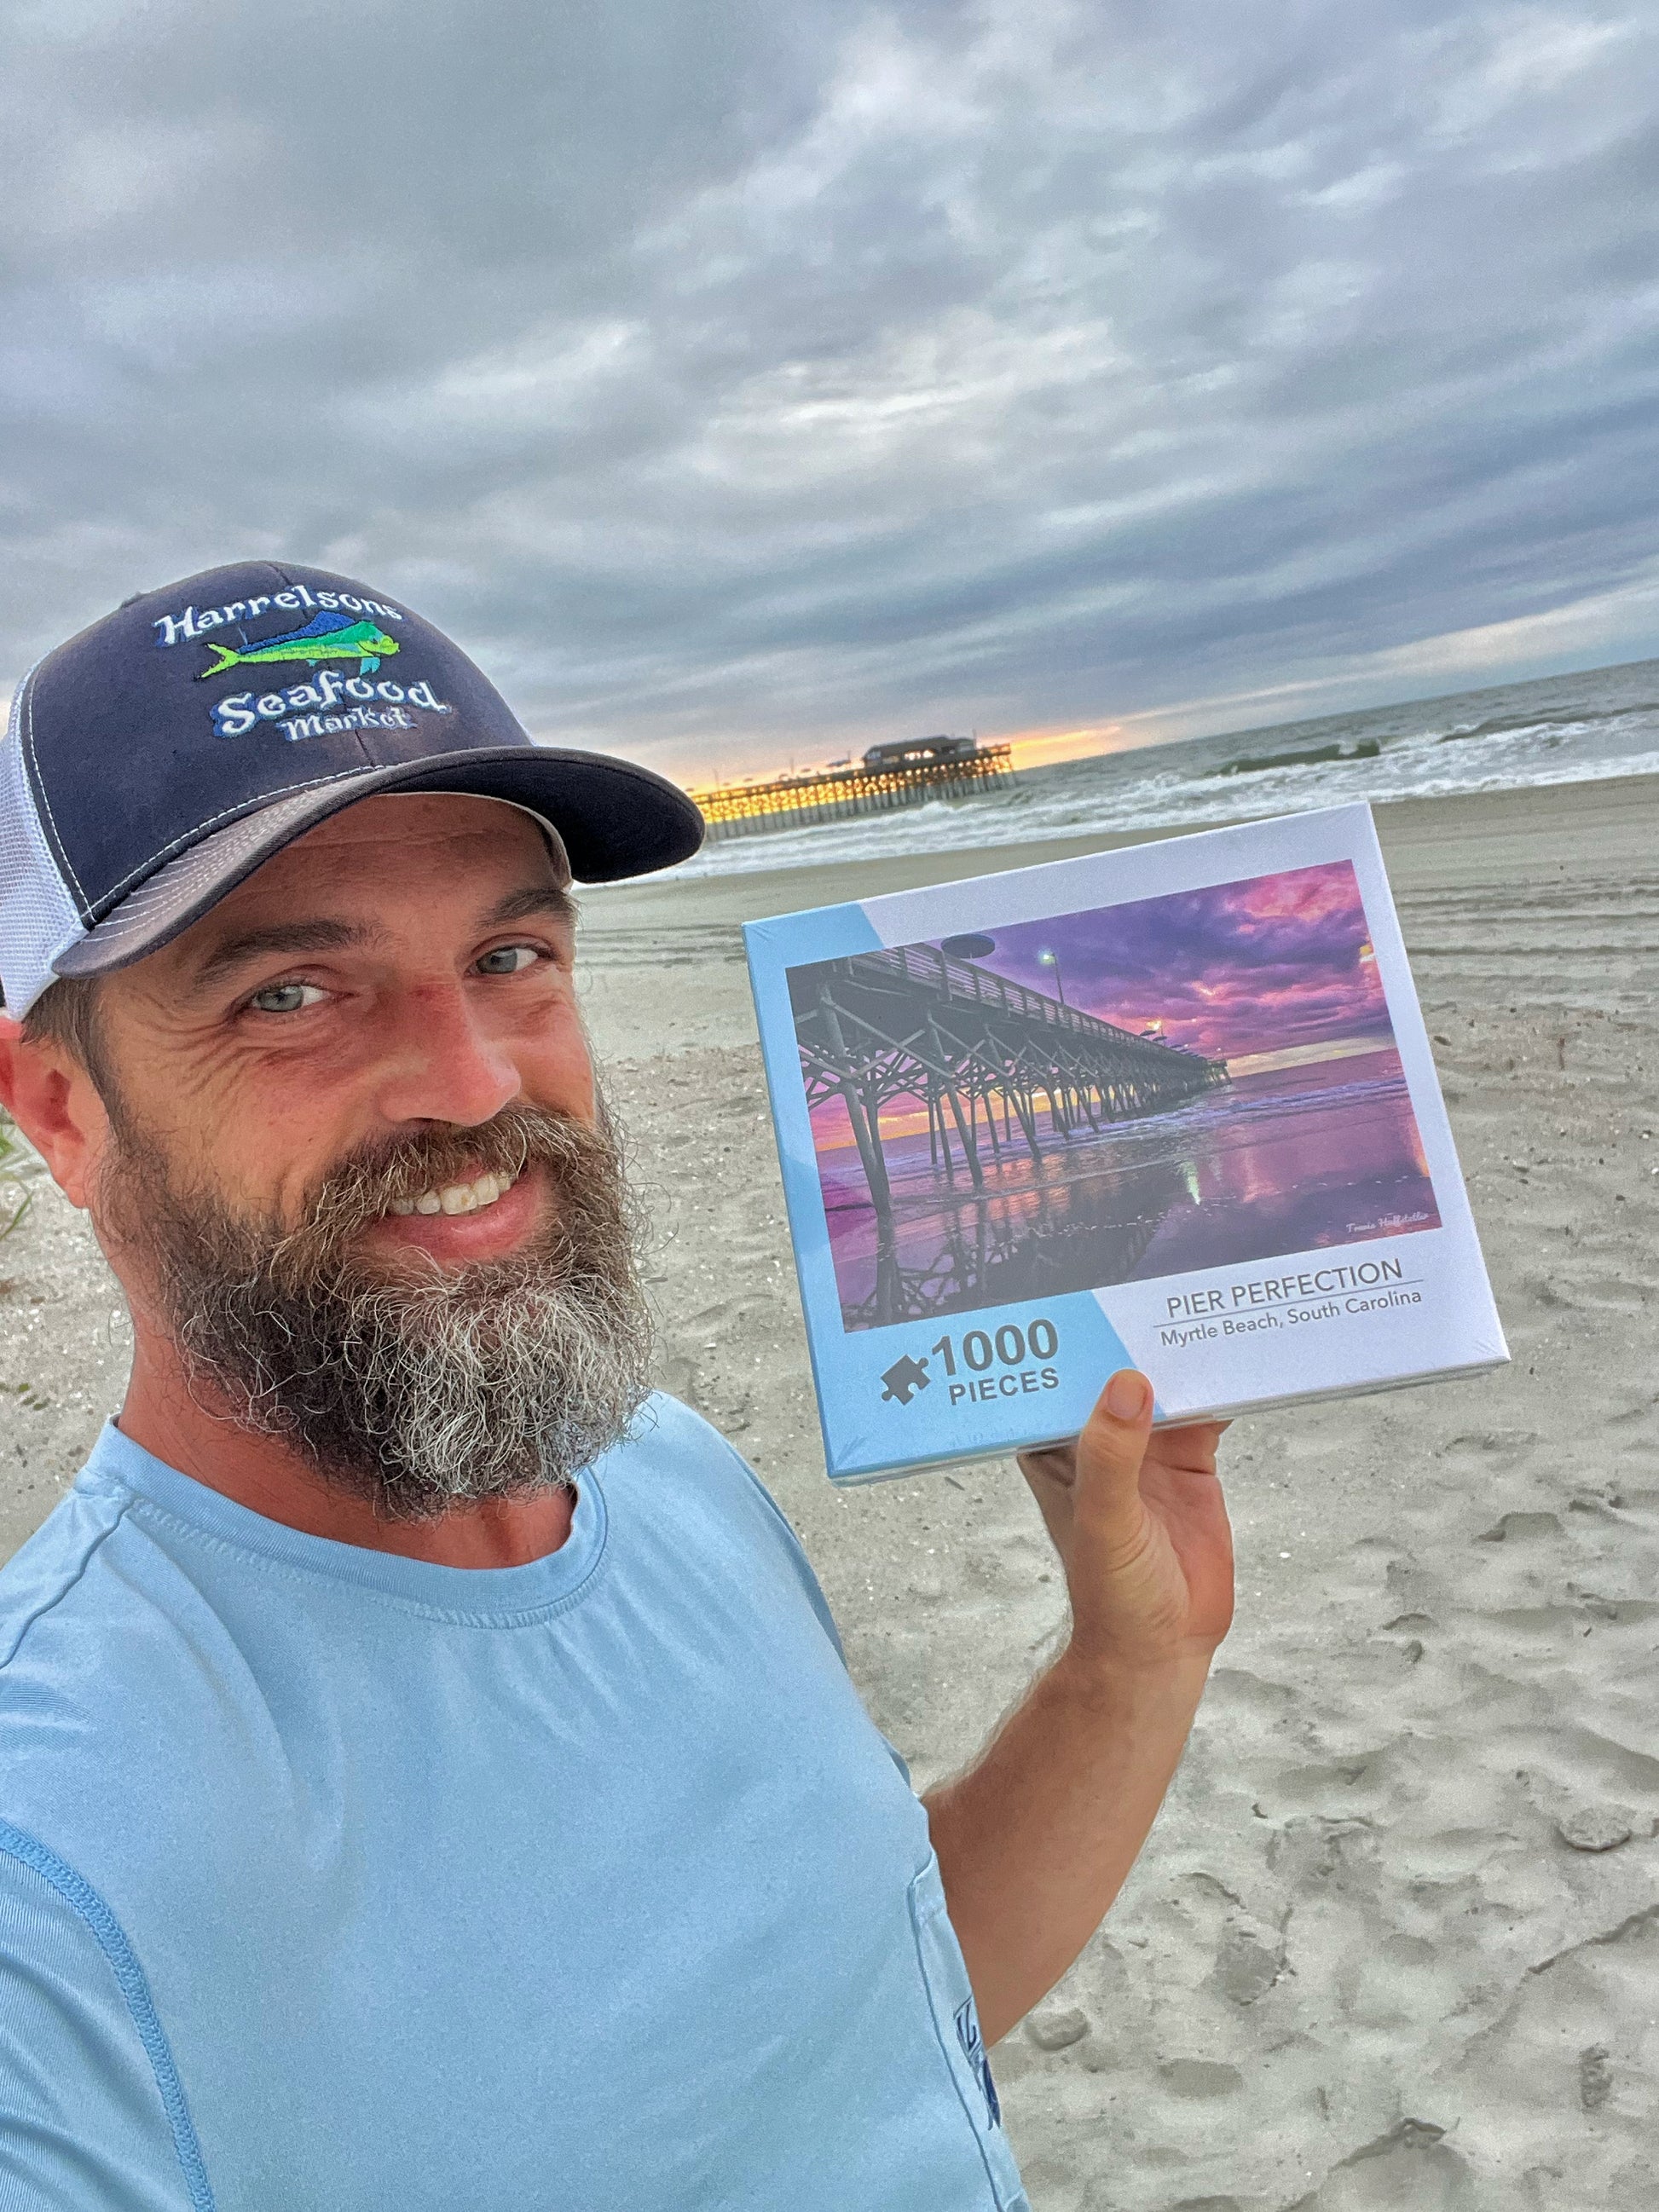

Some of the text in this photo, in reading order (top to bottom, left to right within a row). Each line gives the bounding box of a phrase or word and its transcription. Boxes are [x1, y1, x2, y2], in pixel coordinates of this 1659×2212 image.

[153, 584, 403, 645] Harrelsons
[216, 669, 452, 736] Seafood
[280, 707, 414, 740] Market
[1160, 1288, 1423, 1348] Myrtle Beach, South Carolina
[1166, 1257, 1403, 1319] PIER PERFECTION
[931, 1318, 1059, 1377] 1000
[948, 1366, 1060, 1406] PIECES
